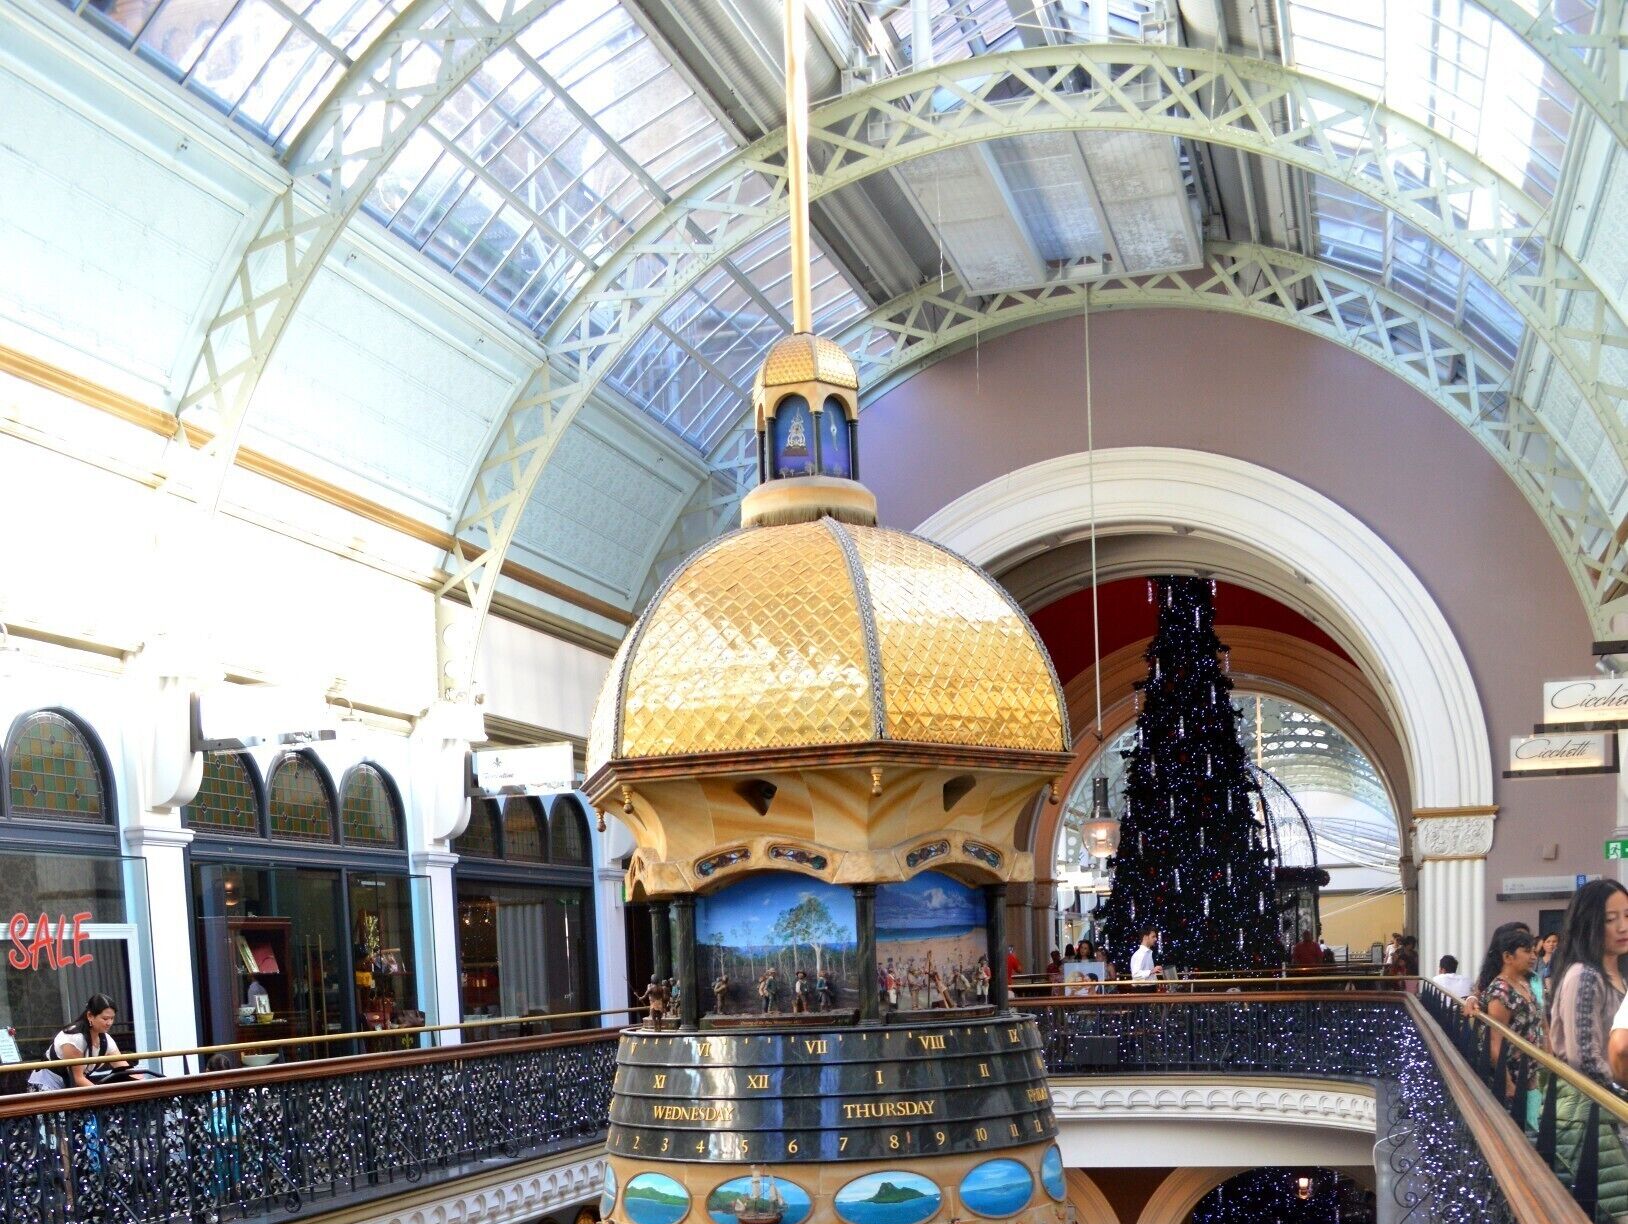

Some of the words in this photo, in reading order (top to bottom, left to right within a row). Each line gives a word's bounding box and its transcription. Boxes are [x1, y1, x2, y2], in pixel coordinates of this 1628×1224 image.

[9, 912, 93, 970] SALE
[696, 1043, 712, 1057] VI
[804, 1039, 828, 1055] VII
[918, 1035, 946, 1050] VIII
[1008, 1028, 1020, 1043] IX
[653, 1074, 666, 1089] XI
[747, 1074, 769, 1089] XII
[875, 1070, 884, 1085] I
[979, 1063, 990, 1078] II
[653, 1105, 736, 1122] WEDNESDAY
[843, 1100, 936, 1119] THURSDAY
[633, 1136, 640, 1150] 2
[661, 1137, 669, 1152] 3
[696, 1139, 705, 1153] 4
[740, 1139, 749, 1154] 5
[788, 1139, 798, 1154] 6
[839, 1136, 848, 1151] 7
[889, 1134, 899, 1149] 8
[936, 1131, 945, 1146] 9
[975, 1127, 988, 1142] 10
[1009, 1123, 1020, 1137] 11
